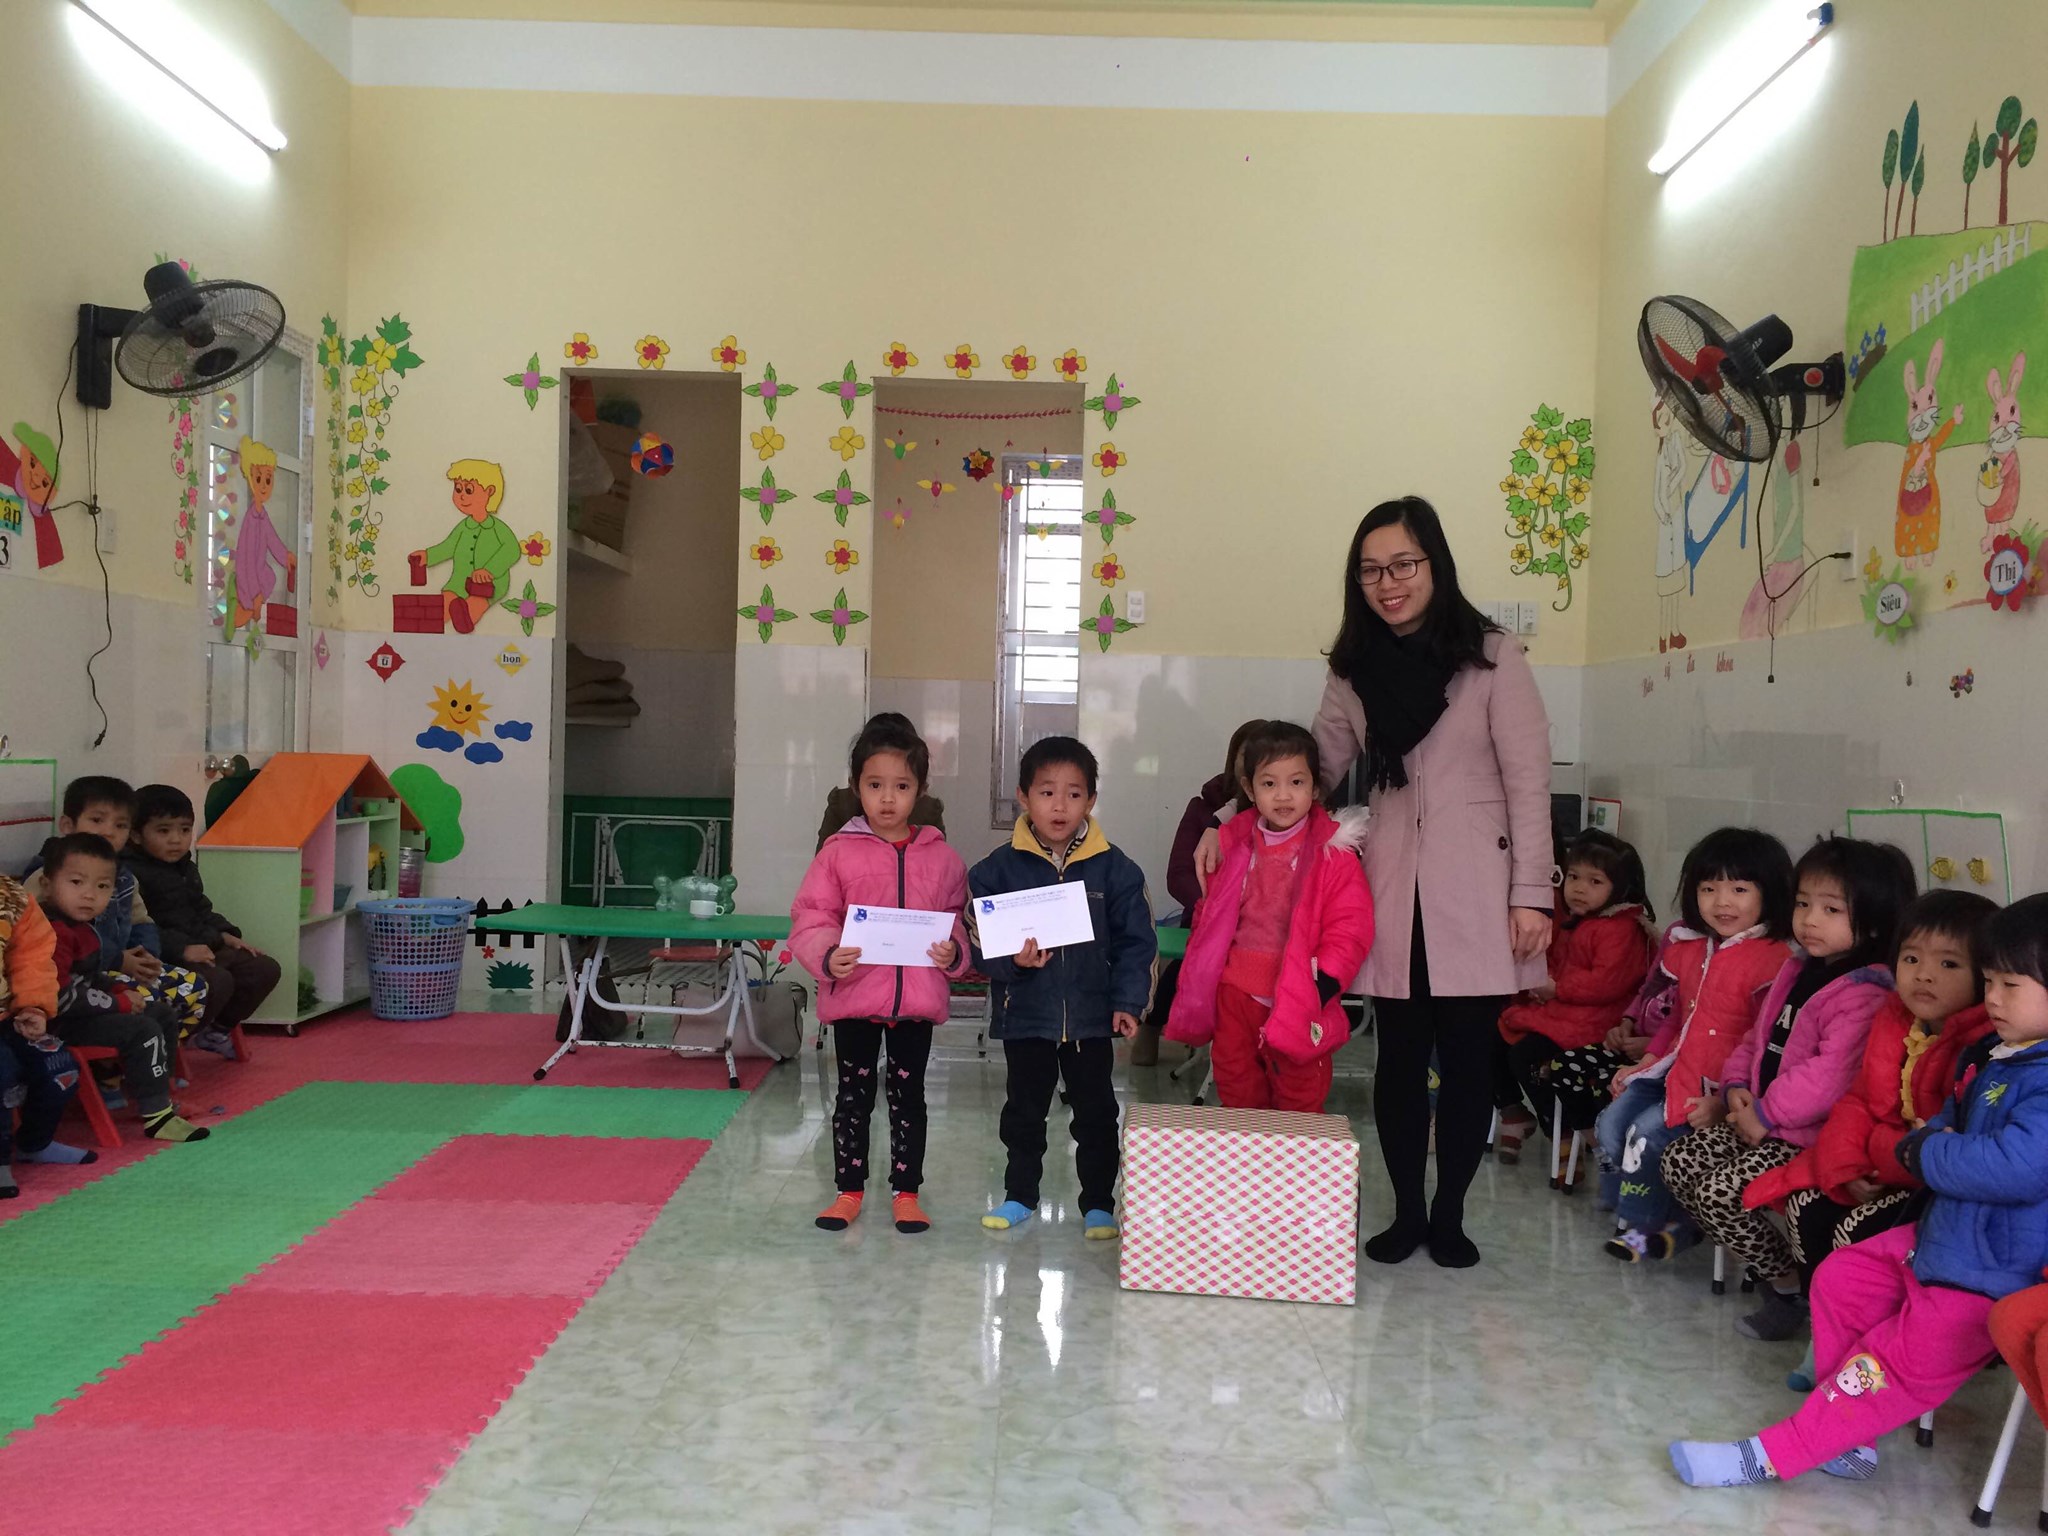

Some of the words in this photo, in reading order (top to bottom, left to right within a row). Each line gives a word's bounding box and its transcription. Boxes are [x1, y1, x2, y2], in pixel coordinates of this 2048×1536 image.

[0, 497, 22, 531] ập
[1995, 562, 2016, 585] Thị
[1880, 594, 1902, 614] Siêu
